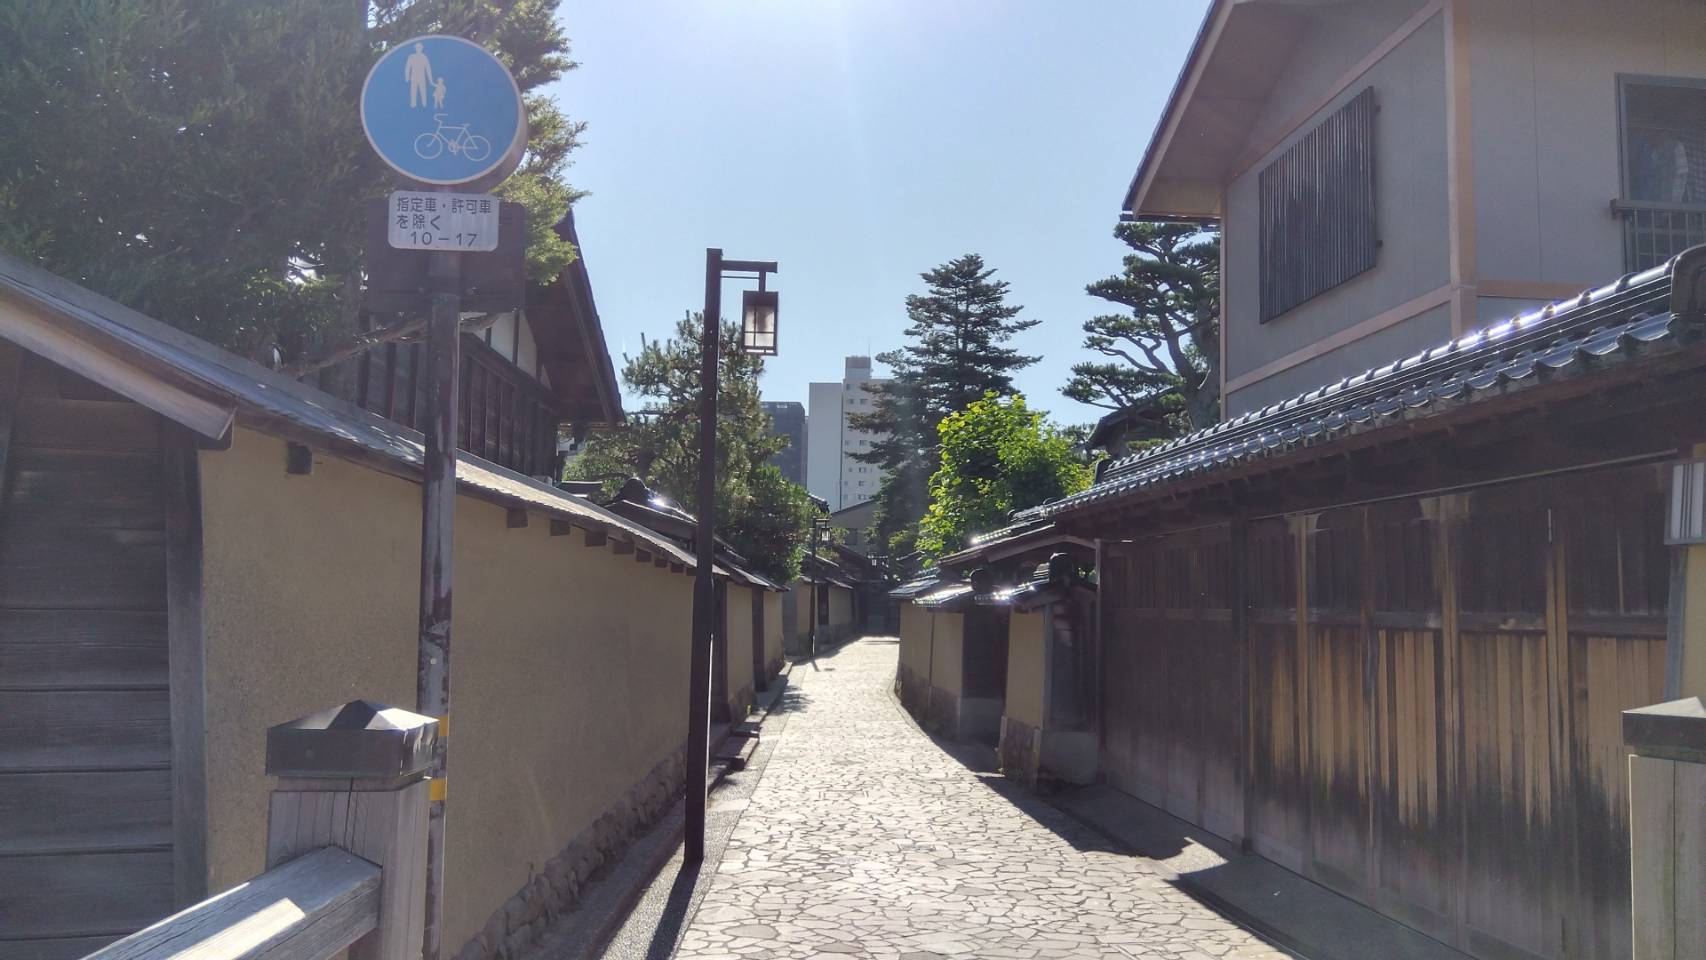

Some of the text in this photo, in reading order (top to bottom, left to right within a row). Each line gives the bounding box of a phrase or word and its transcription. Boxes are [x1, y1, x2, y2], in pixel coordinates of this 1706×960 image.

[397, 197, 491, 214] 指定車・許可車
[396, 215, 441, 230] を除く
